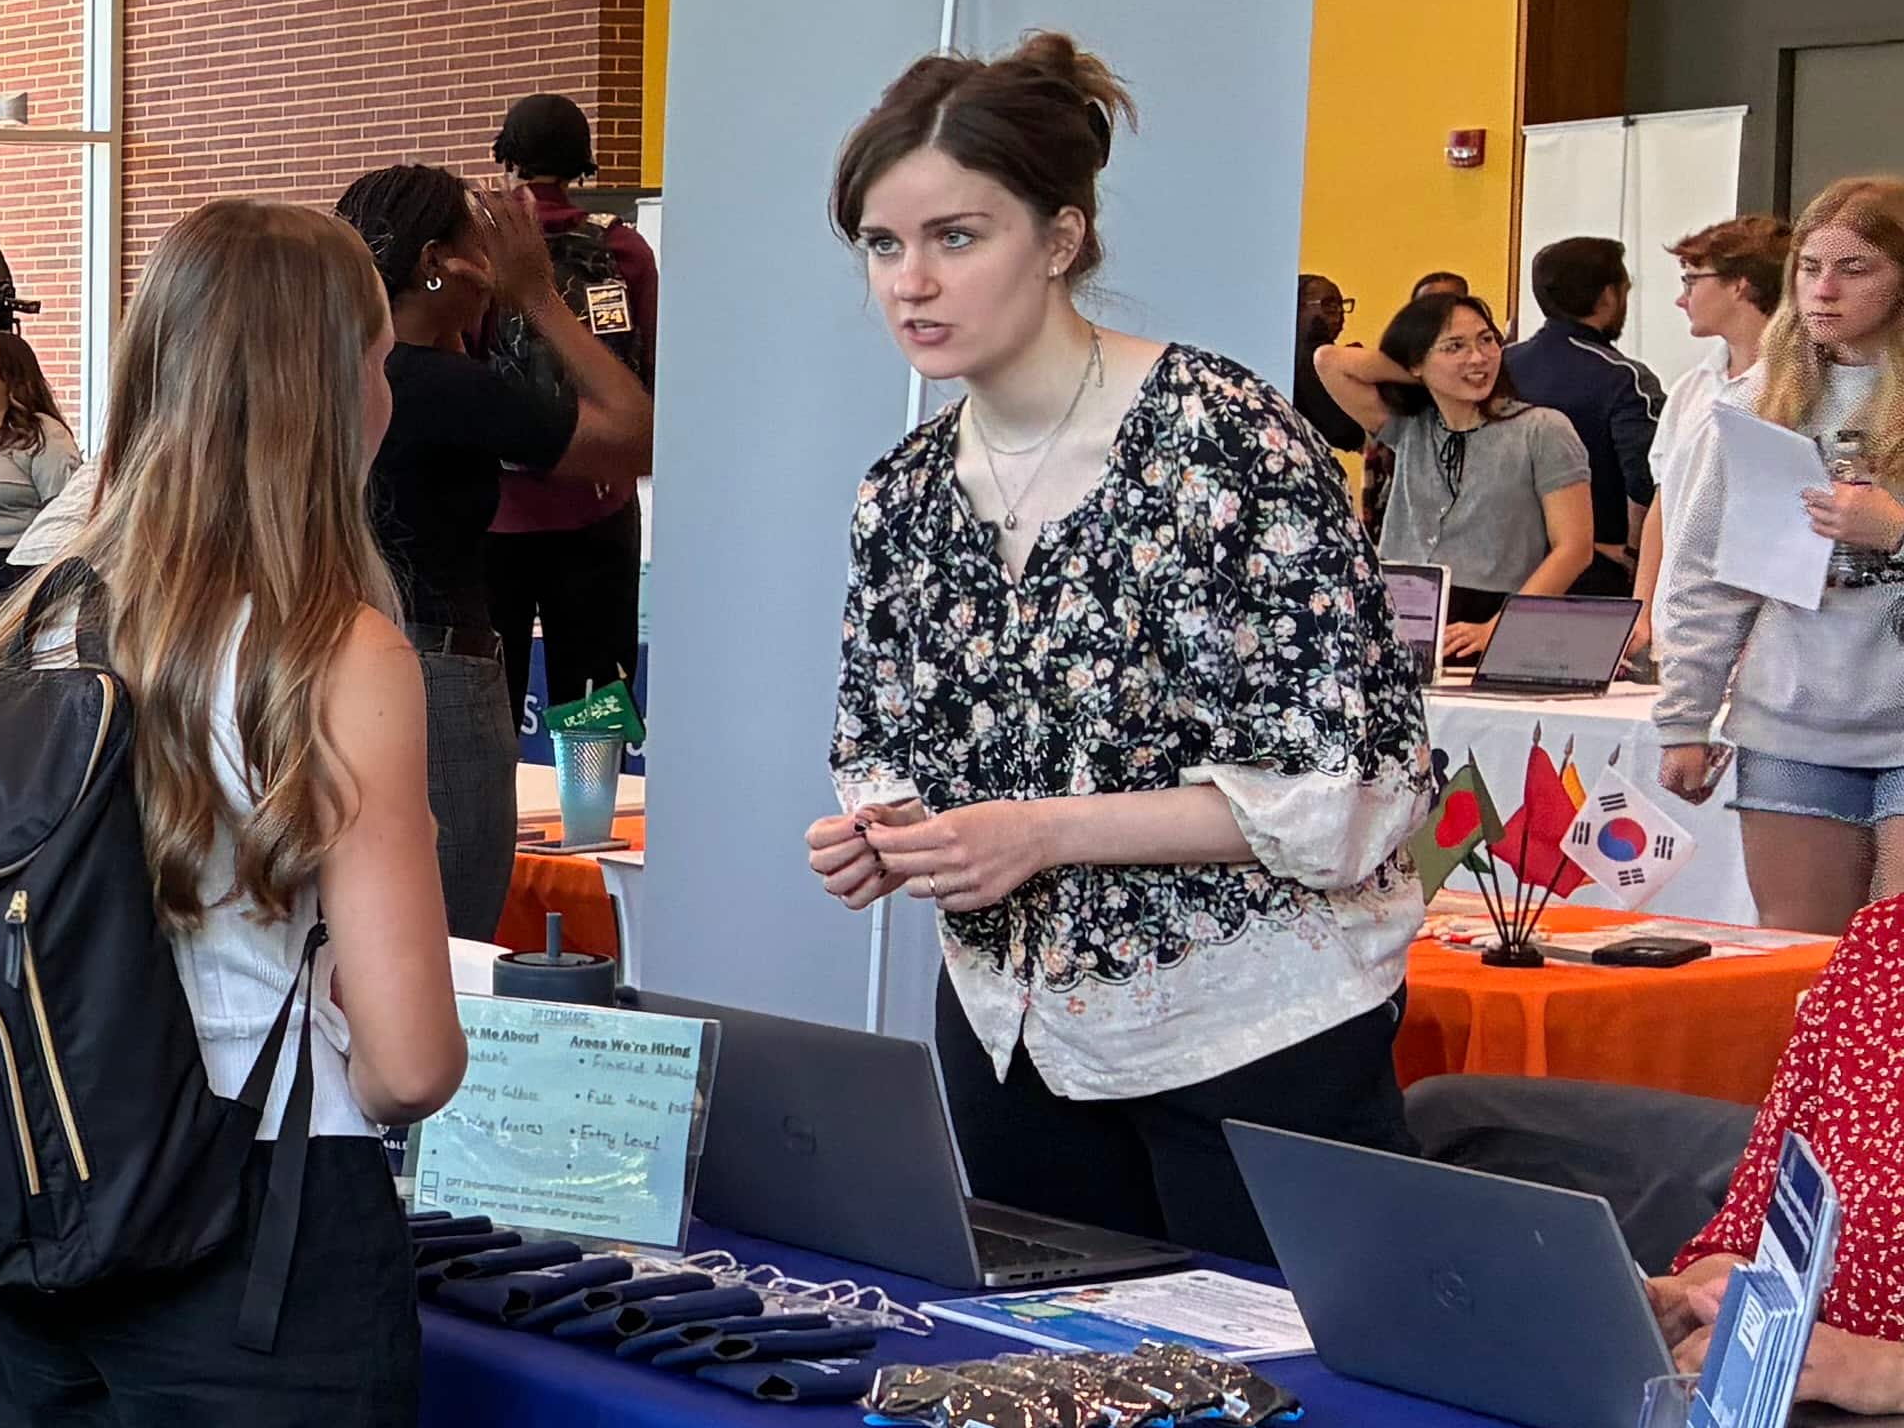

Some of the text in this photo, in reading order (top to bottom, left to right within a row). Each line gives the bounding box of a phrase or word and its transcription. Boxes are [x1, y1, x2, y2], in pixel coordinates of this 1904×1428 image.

[480, 1027, 499, 1038] Me
[501, 1029, 540, 1044] About
[570, 1035, 608, 1050] Areas
[651, 1042, 692, 1059] Hiring
